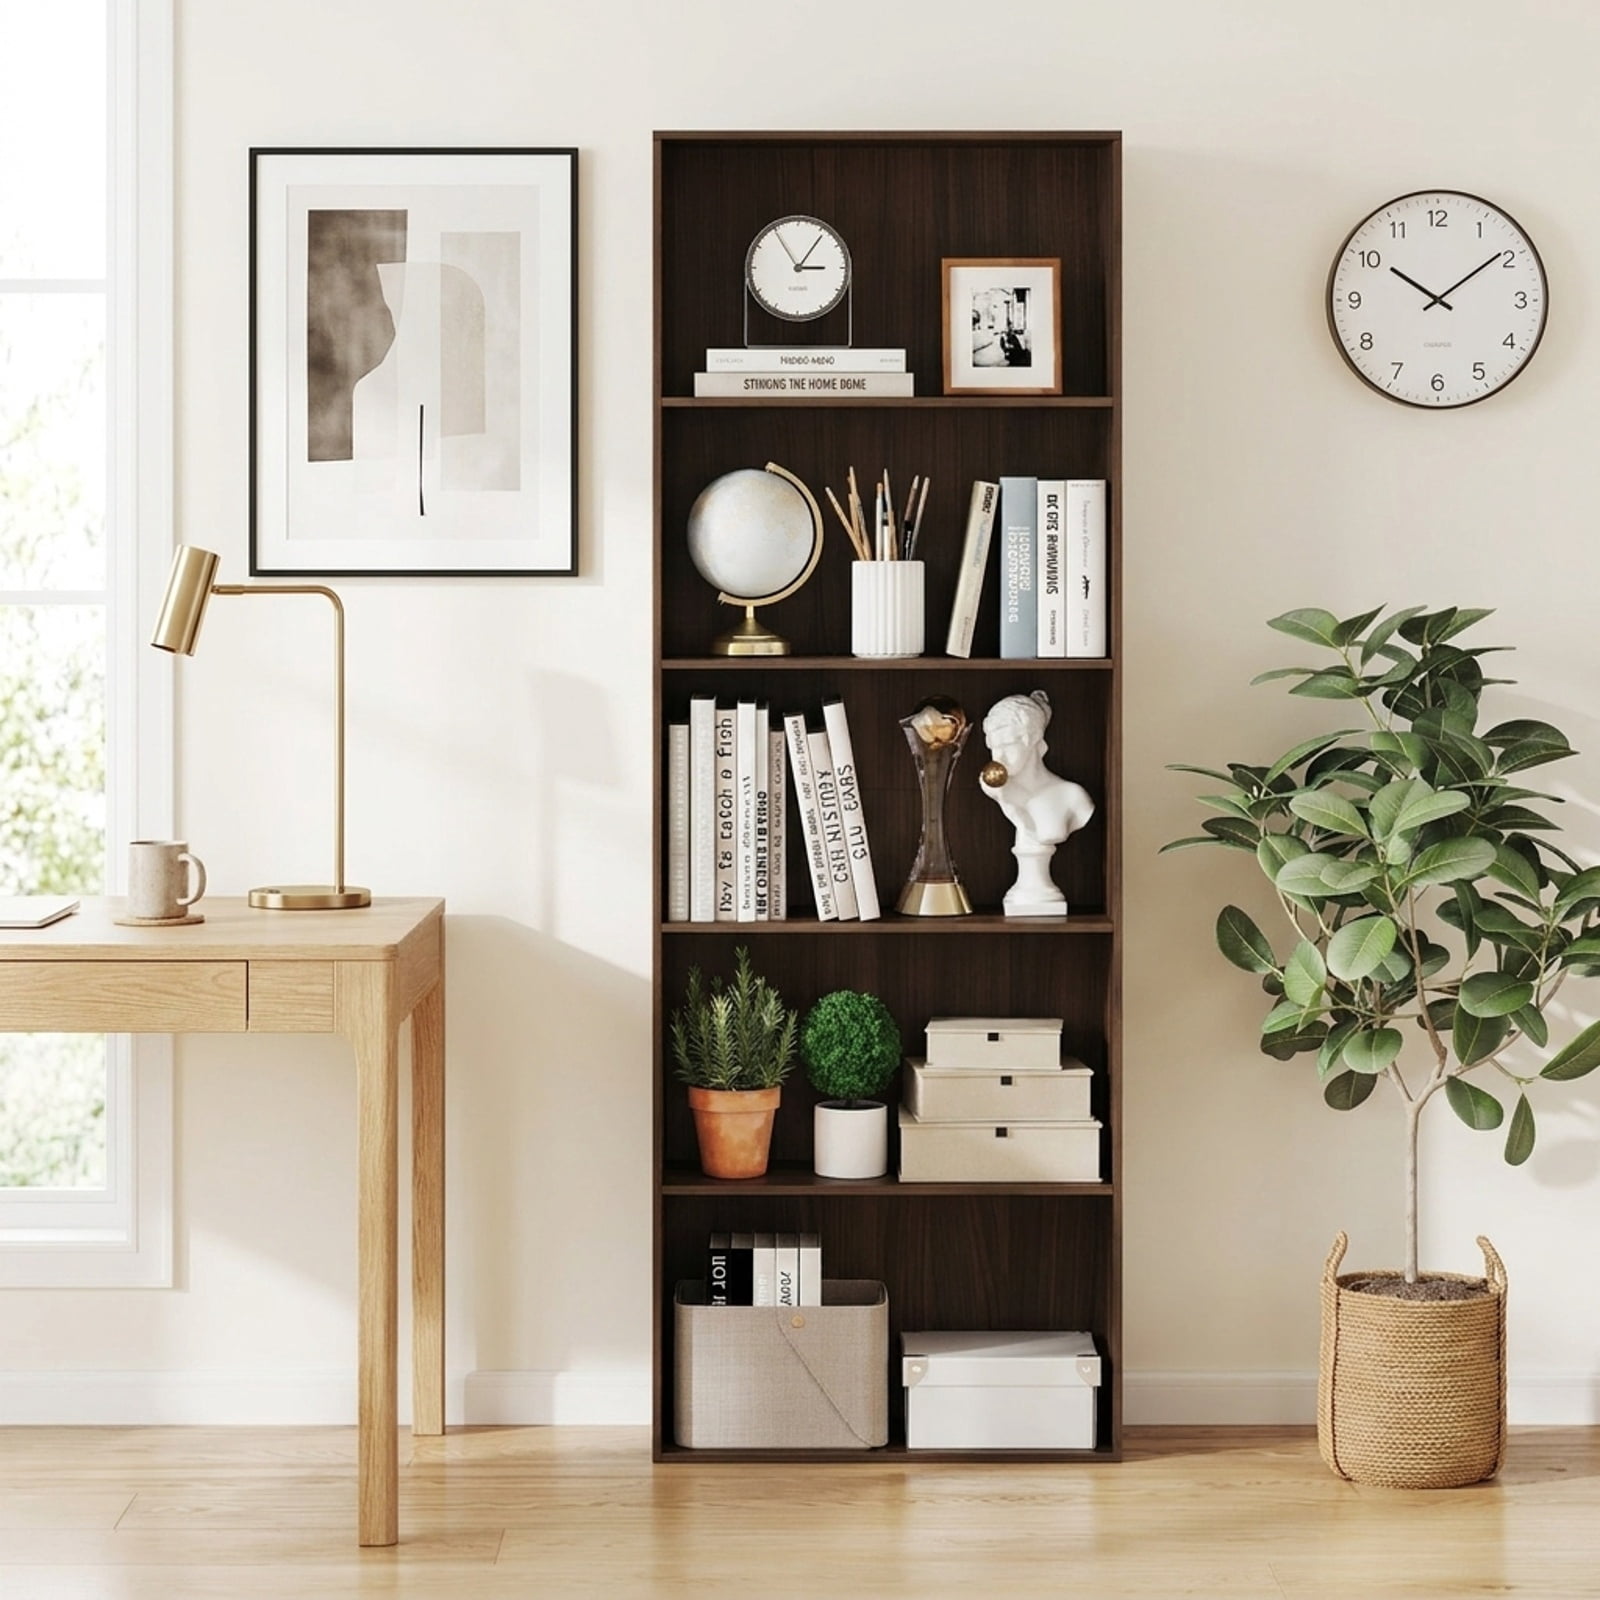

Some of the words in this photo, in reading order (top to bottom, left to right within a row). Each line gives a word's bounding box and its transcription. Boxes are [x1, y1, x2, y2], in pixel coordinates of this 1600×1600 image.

[1427, 209, 1448, 227] 12
[1389, 221, 1406, 238] 11
[1476, 221, 1482, 238] 1
[1358, 250, 1381, 268] 10
[1502, 250, 1516, 268] 2
[1348, 291, 1362, 309] 9
[1514, 291, 1528, 309] 3
[1360, 332, 1374, 350] 8
[1502, 332, 1516, 349] 4
[1391, 362, 1404, 380] 7
[1472, 362, 1485, 380] 5
[808, 378, 837, 391] HOME
[1431, 374, 1445, 392] 6
